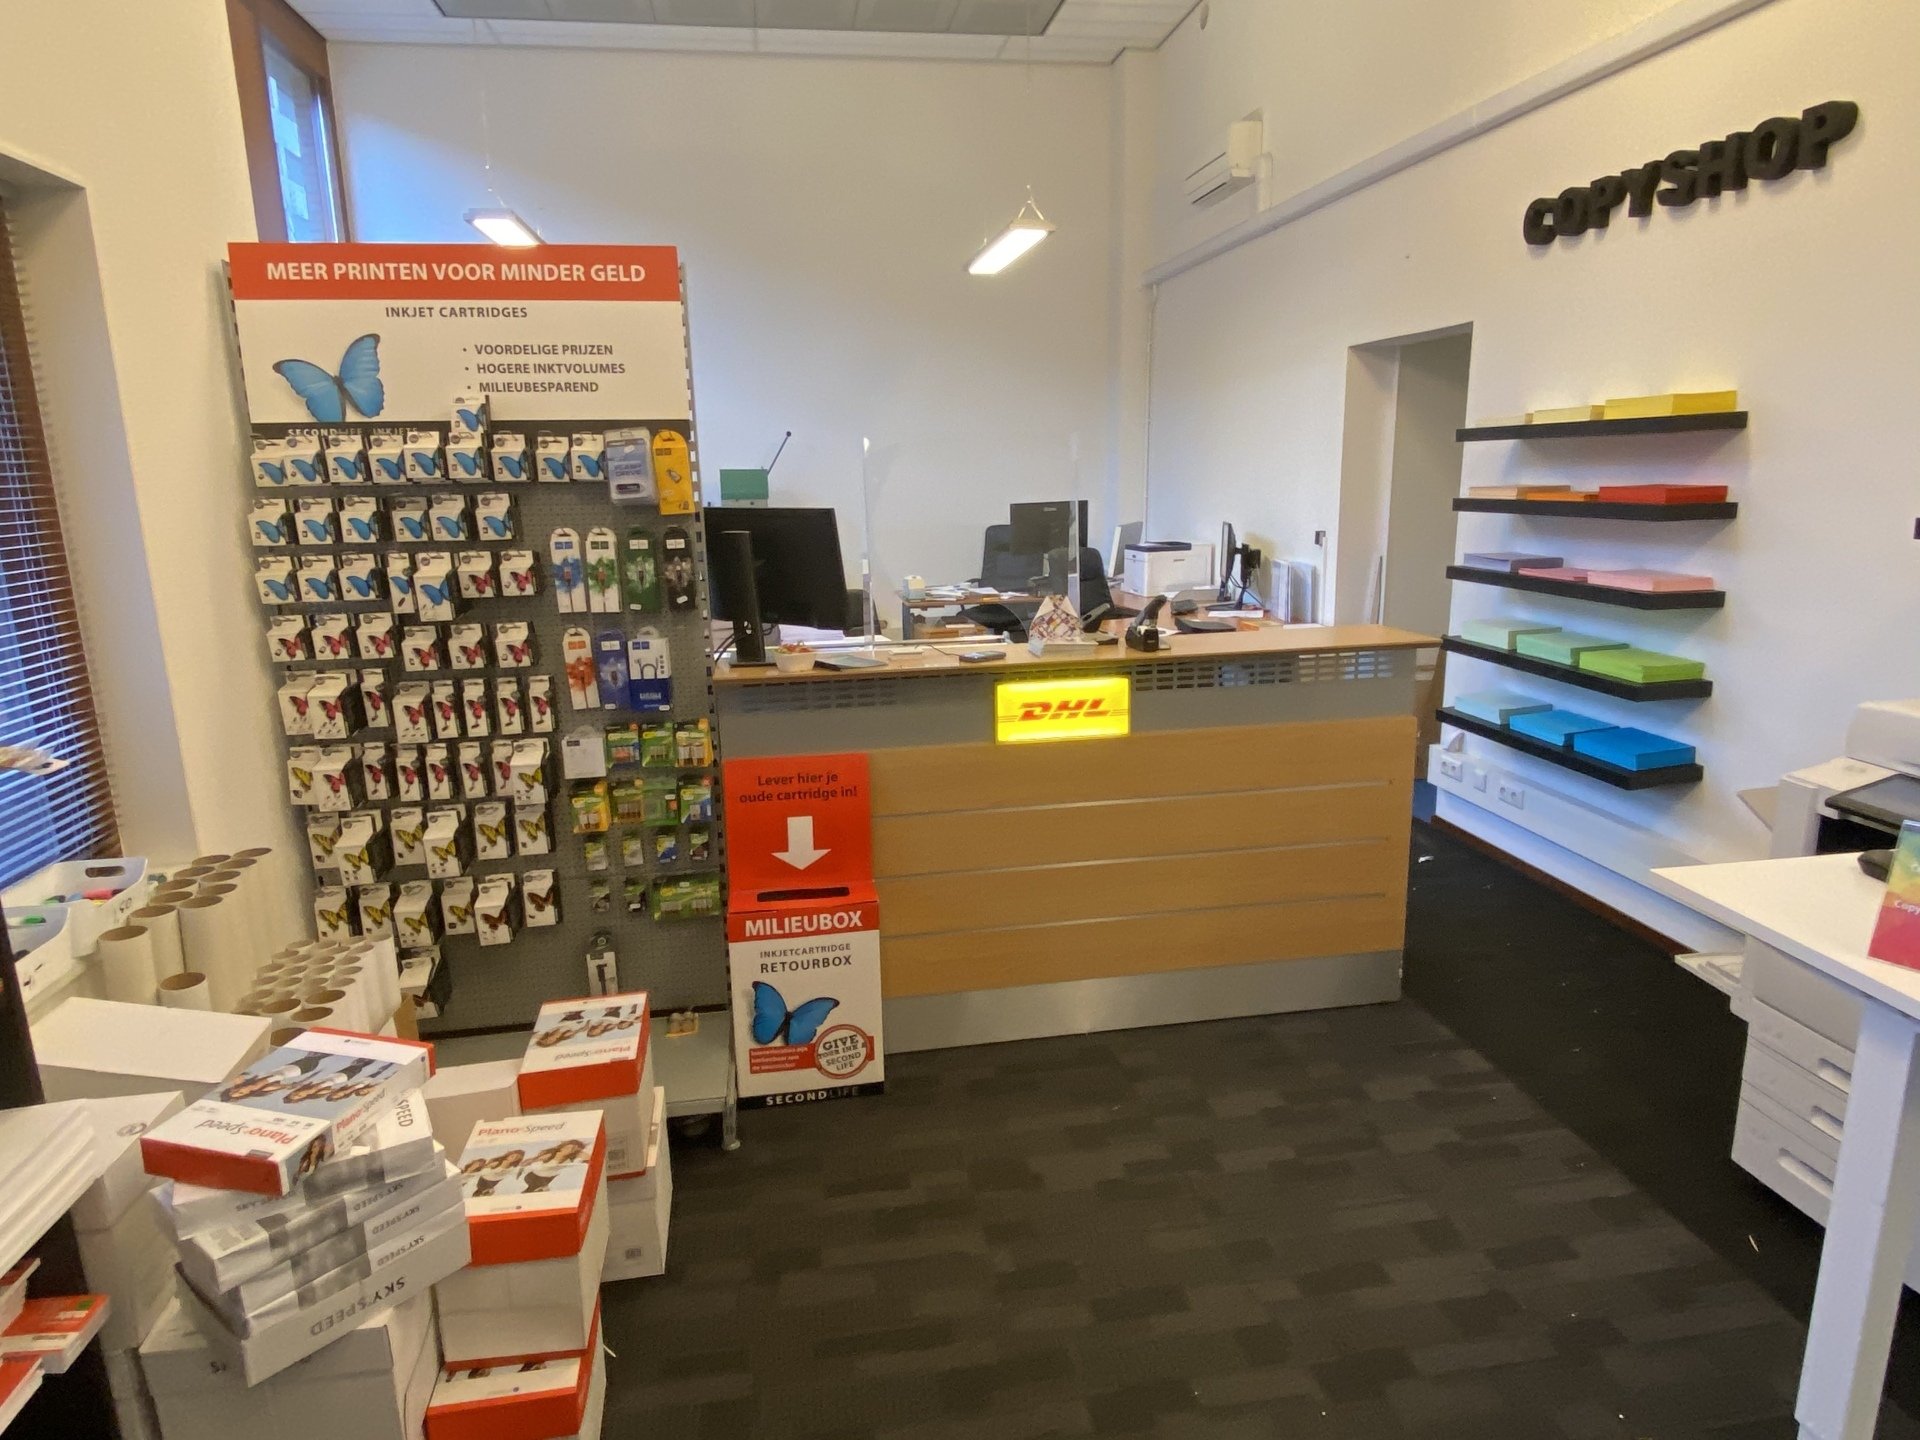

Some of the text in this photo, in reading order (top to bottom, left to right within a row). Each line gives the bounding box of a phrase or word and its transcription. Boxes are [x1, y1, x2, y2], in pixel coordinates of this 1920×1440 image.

[1524, 100, 1859, 246] COPYSHOP
[267, 262, 646, 282] MEER PRINTEN VOOR MINDER GELD
[385, 306, 528, 318] INKJET CARTRIDGES
[475, 344, 614, 355] VOORDELIGE PRIJZEN
[477, 363, 626, 374] HOGERE INKTVOLUMES
[479, 382, 599, 393] MILIEUBESPAREND
[1017, 698, 1111, 722] DHL
[757, 772, 838, 786] Lever hier je
[739, 785, 858, 803] oude cartridge in!
[744, 910, 863, 937] MILIEUBOX
[760, 943, 851, 959] INKJETCARTRIDGE
[760, 955, 852, 974] RETOURBOX
[822, 1034, 859, 1051] GIVE
[766, 1086, 861, 1106] SECONDLIFE
[194, 1118, 247, 1135] Speed
[478, 1121, 567, 1137] Plano Speed
[249, 1126, 299, 1145] Plano
